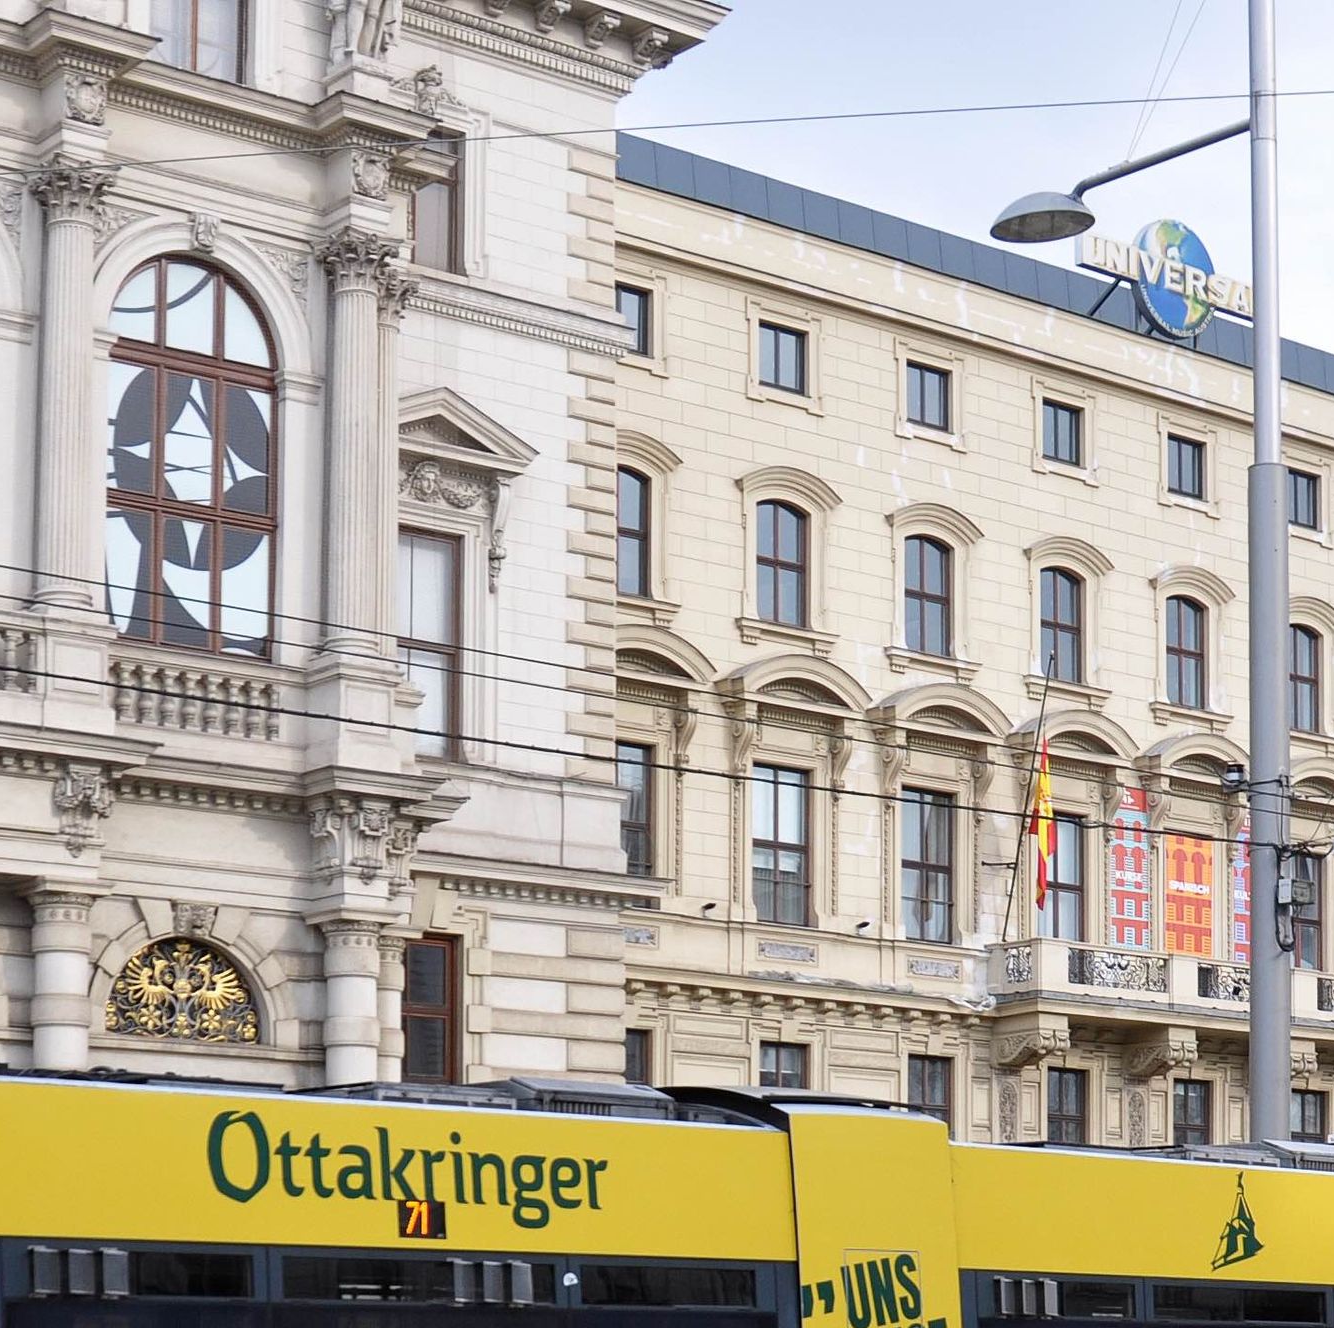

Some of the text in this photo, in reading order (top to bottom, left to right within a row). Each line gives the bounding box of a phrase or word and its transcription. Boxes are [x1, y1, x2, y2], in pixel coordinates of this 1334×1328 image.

[1082, 237, 1253, 314] UNIVERSA
[207, 1110, 608, 1230] Ottakringer
[405, 1201, 428, 1235] 71
